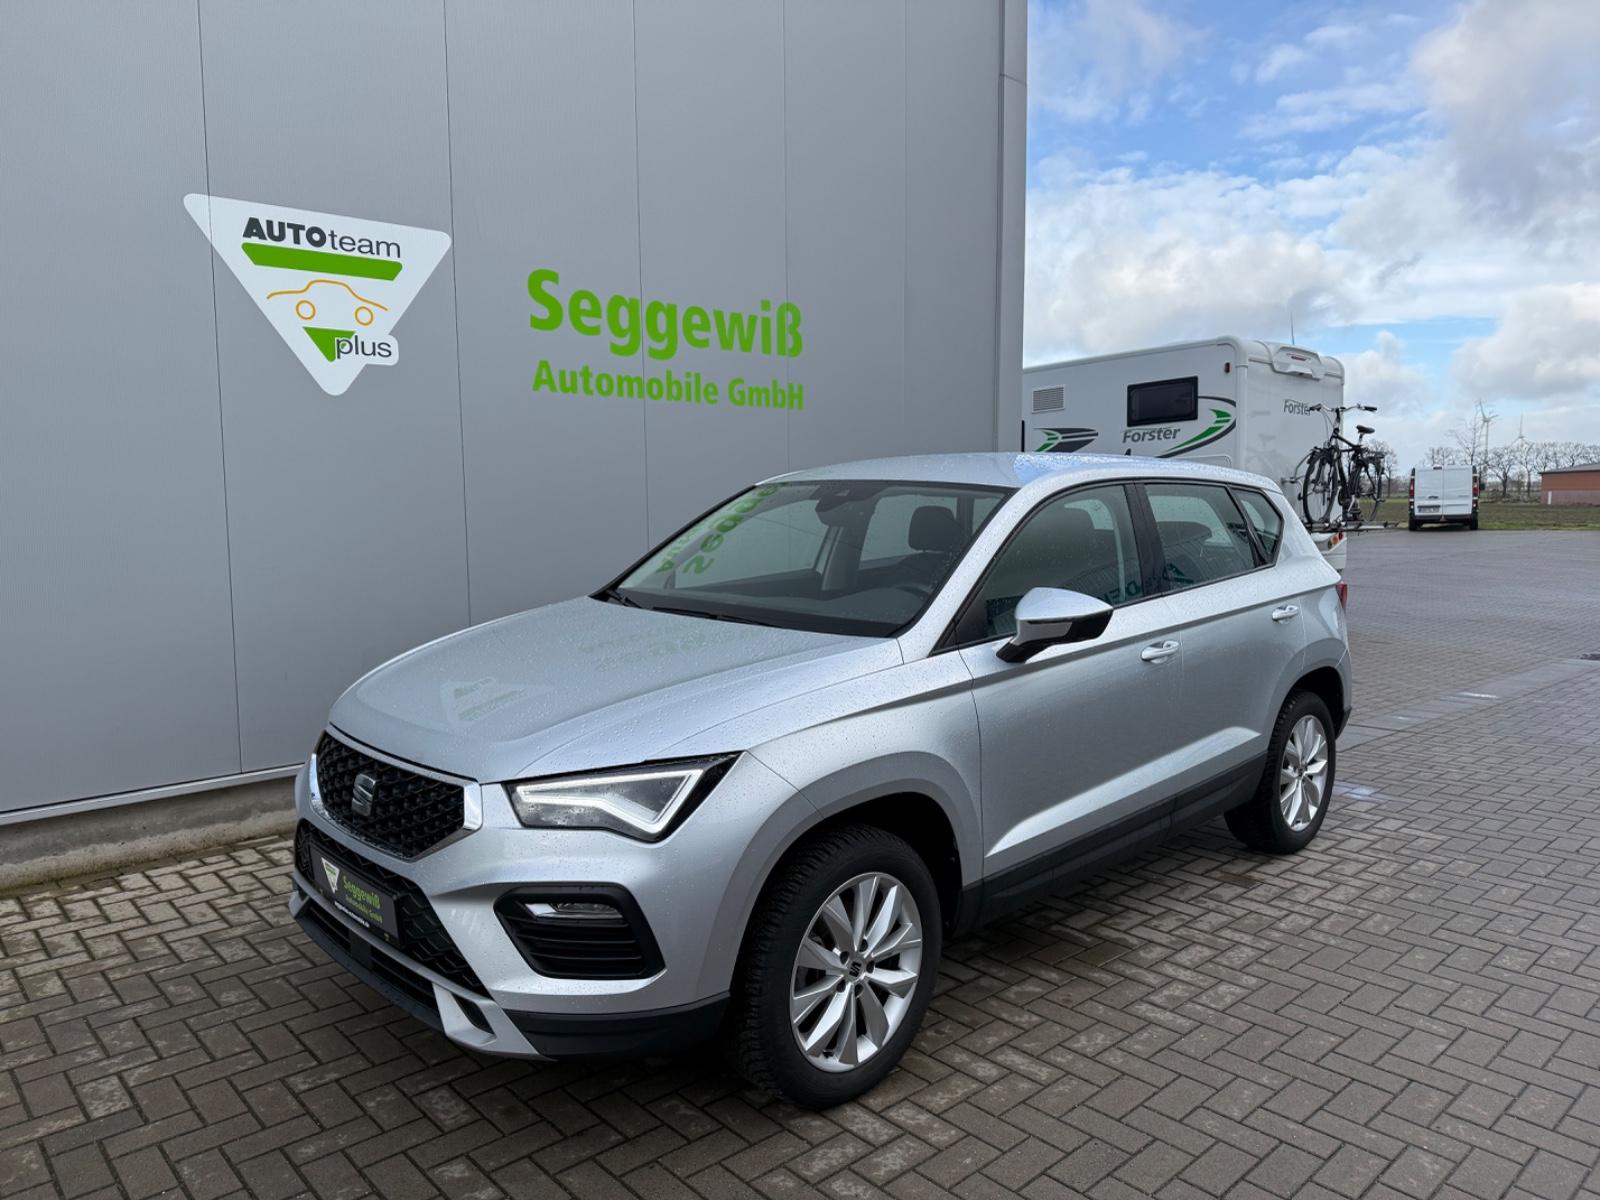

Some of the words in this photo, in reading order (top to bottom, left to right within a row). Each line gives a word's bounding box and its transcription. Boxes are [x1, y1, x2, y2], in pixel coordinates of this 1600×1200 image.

[242, 216, 401, 259] AUTOteam
[527, 268, 803, 359] Seggewiß
[335, 334, 392, 360] plus
[532, 359, 719, 405] Automobile
[728, 377, 804, 410] GmbH
[1122, 427, 1181, 444] Forster
